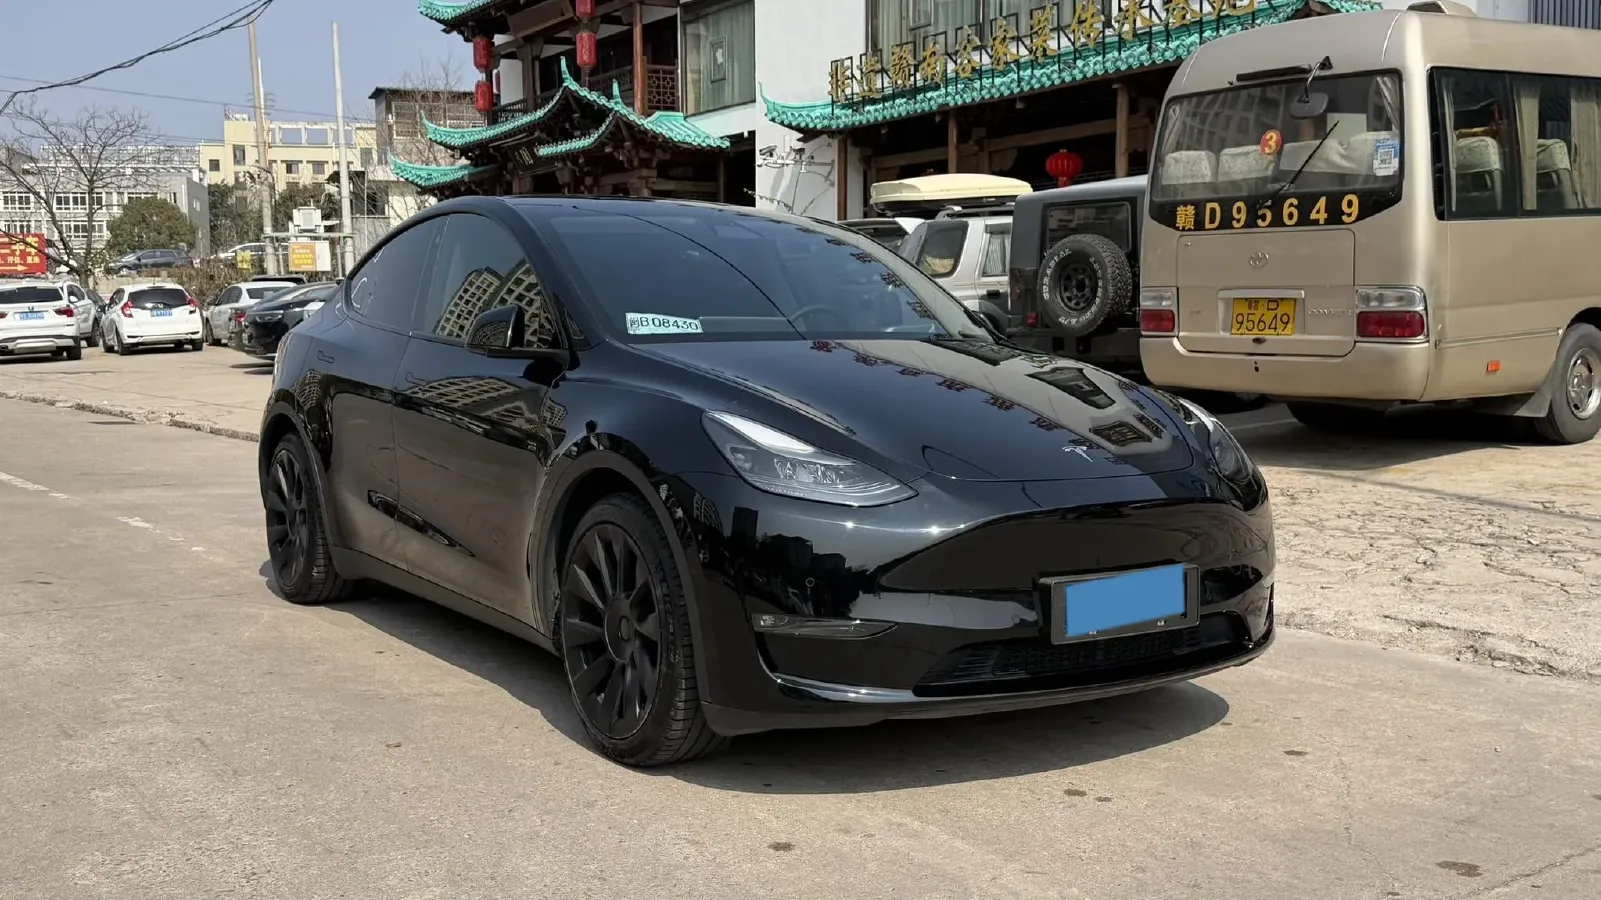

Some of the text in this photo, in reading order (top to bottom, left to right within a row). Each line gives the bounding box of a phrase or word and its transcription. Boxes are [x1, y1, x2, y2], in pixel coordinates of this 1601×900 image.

[1264, 132, 1277, 153] 3
[1176, 194, 1359, 230] 赣D95649
[1235, 312, 1290, 332] 95649
